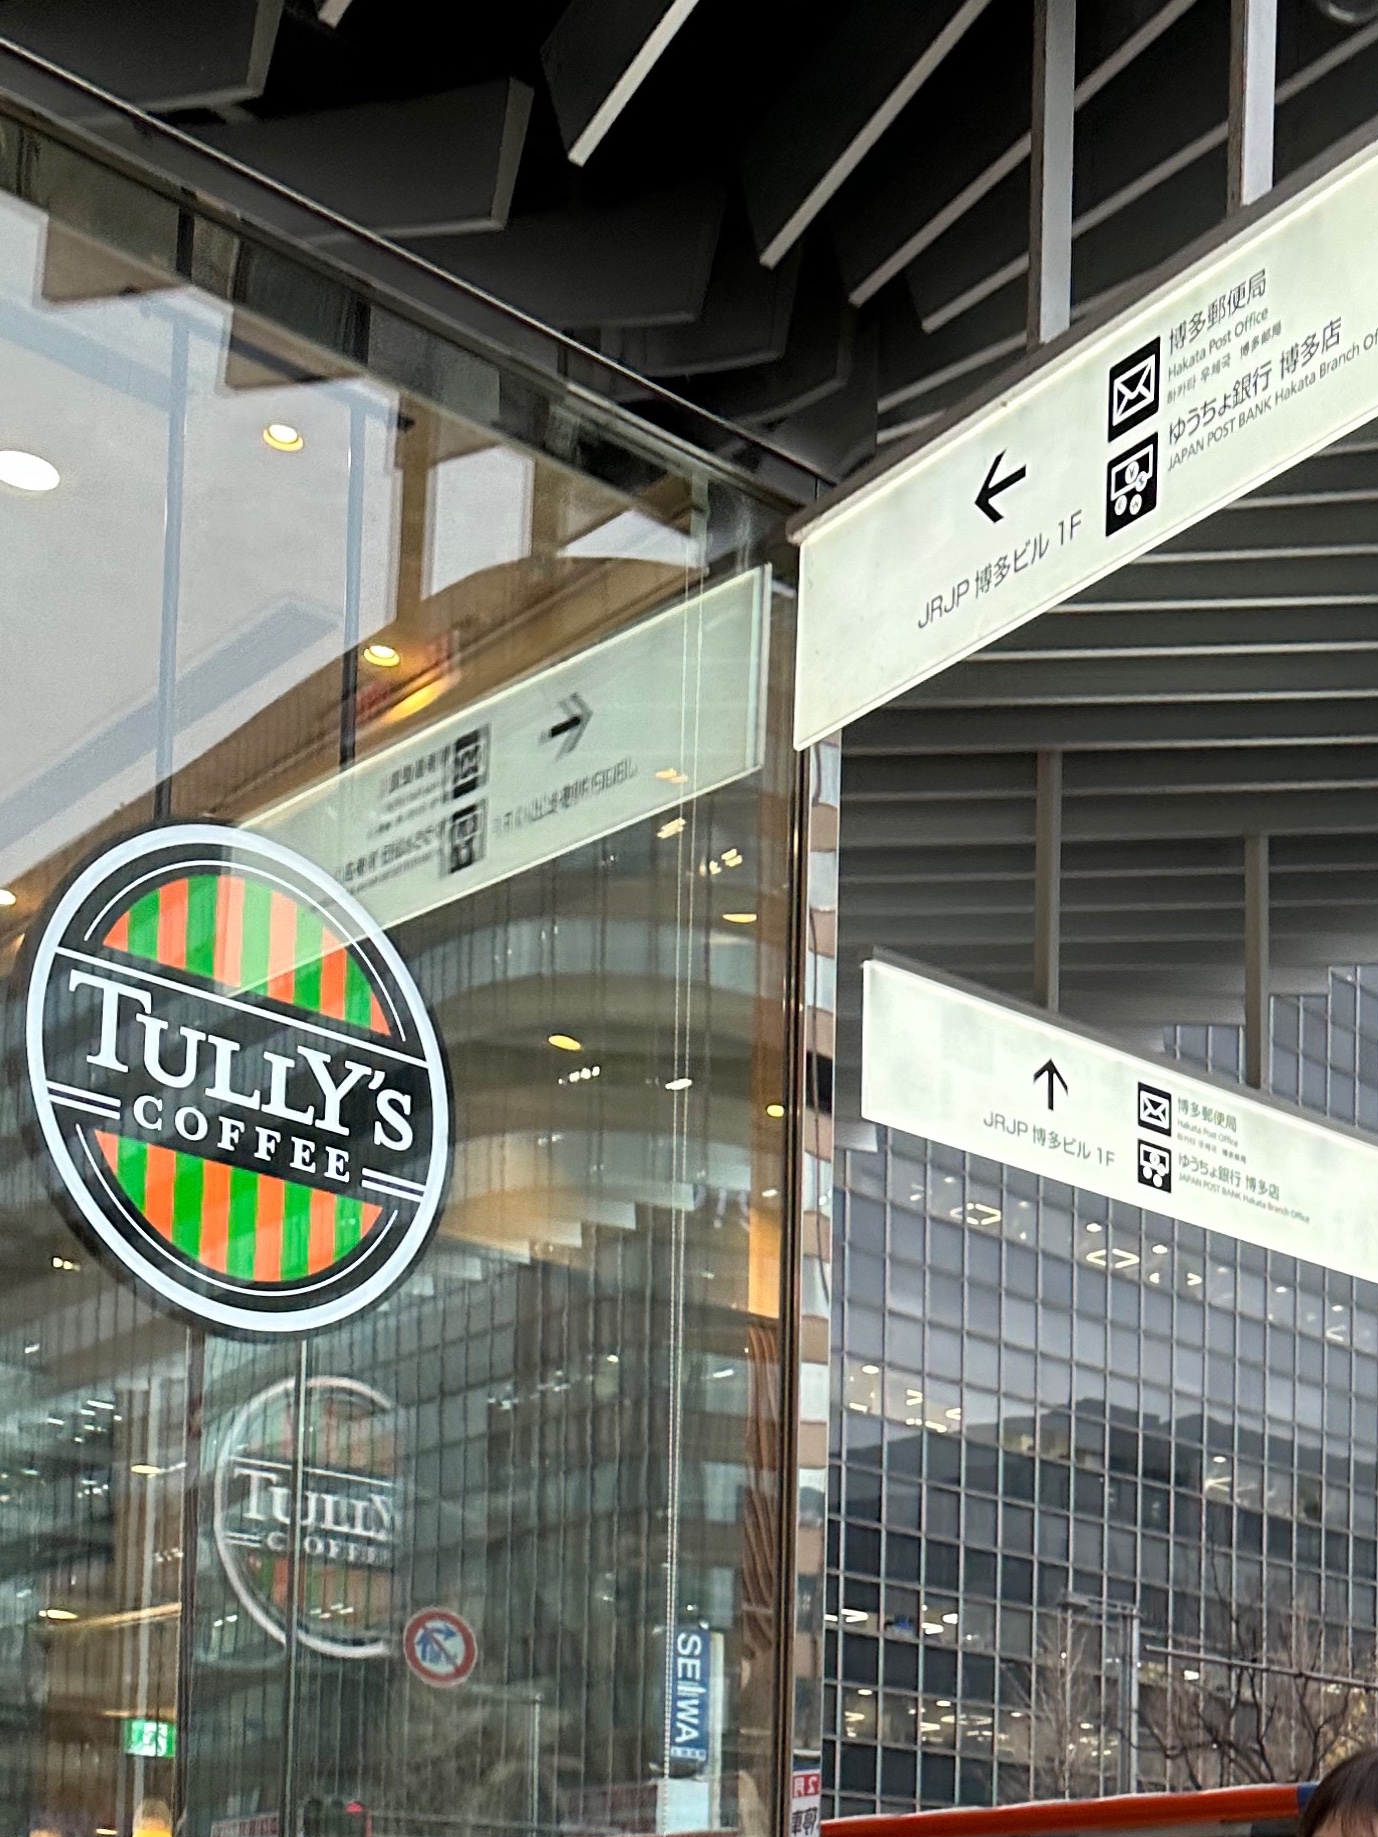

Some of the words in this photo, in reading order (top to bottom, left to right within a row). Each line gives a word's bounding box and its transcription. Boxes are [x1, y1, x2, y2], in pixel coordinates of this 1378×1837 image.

[1168, 347, 1206, 382] Hakata
[1208, 329, 1232, 356] Post
[1234, 306, 1269, 338] Office
[1169, 268, 1267, 355] 博多郵便局
[1168, 440, 1204, 472] JAPAN
[1206, 416, 1235, 449] POST
[1238, 397, 1273, 429] BANK
[1274, 370, 1317, 406] Hakata
[1318, 344, 1360, 380] Branch
[1169, 360, 1273, 445] ゆうちょ銀行
[1279, 316, 1342, 380] 博多店
[917, 579, 970, 629] JRJP
[974, 532, 1050, 600] 博多ビル
[1058, 508, 1083, 546] 1F
[68, 967, 414, 1152] TULLY'S
[133, 1095, 350, 1184] COFFEE
[983, 1110, 1029, 1137] JRJP
[1032, 1124, 1091, 1160] 博多ビル
[1096, 1146, 1116, 1167] 1F
[1178, 1152, 1242, 1188] ゆうちょ銀行
